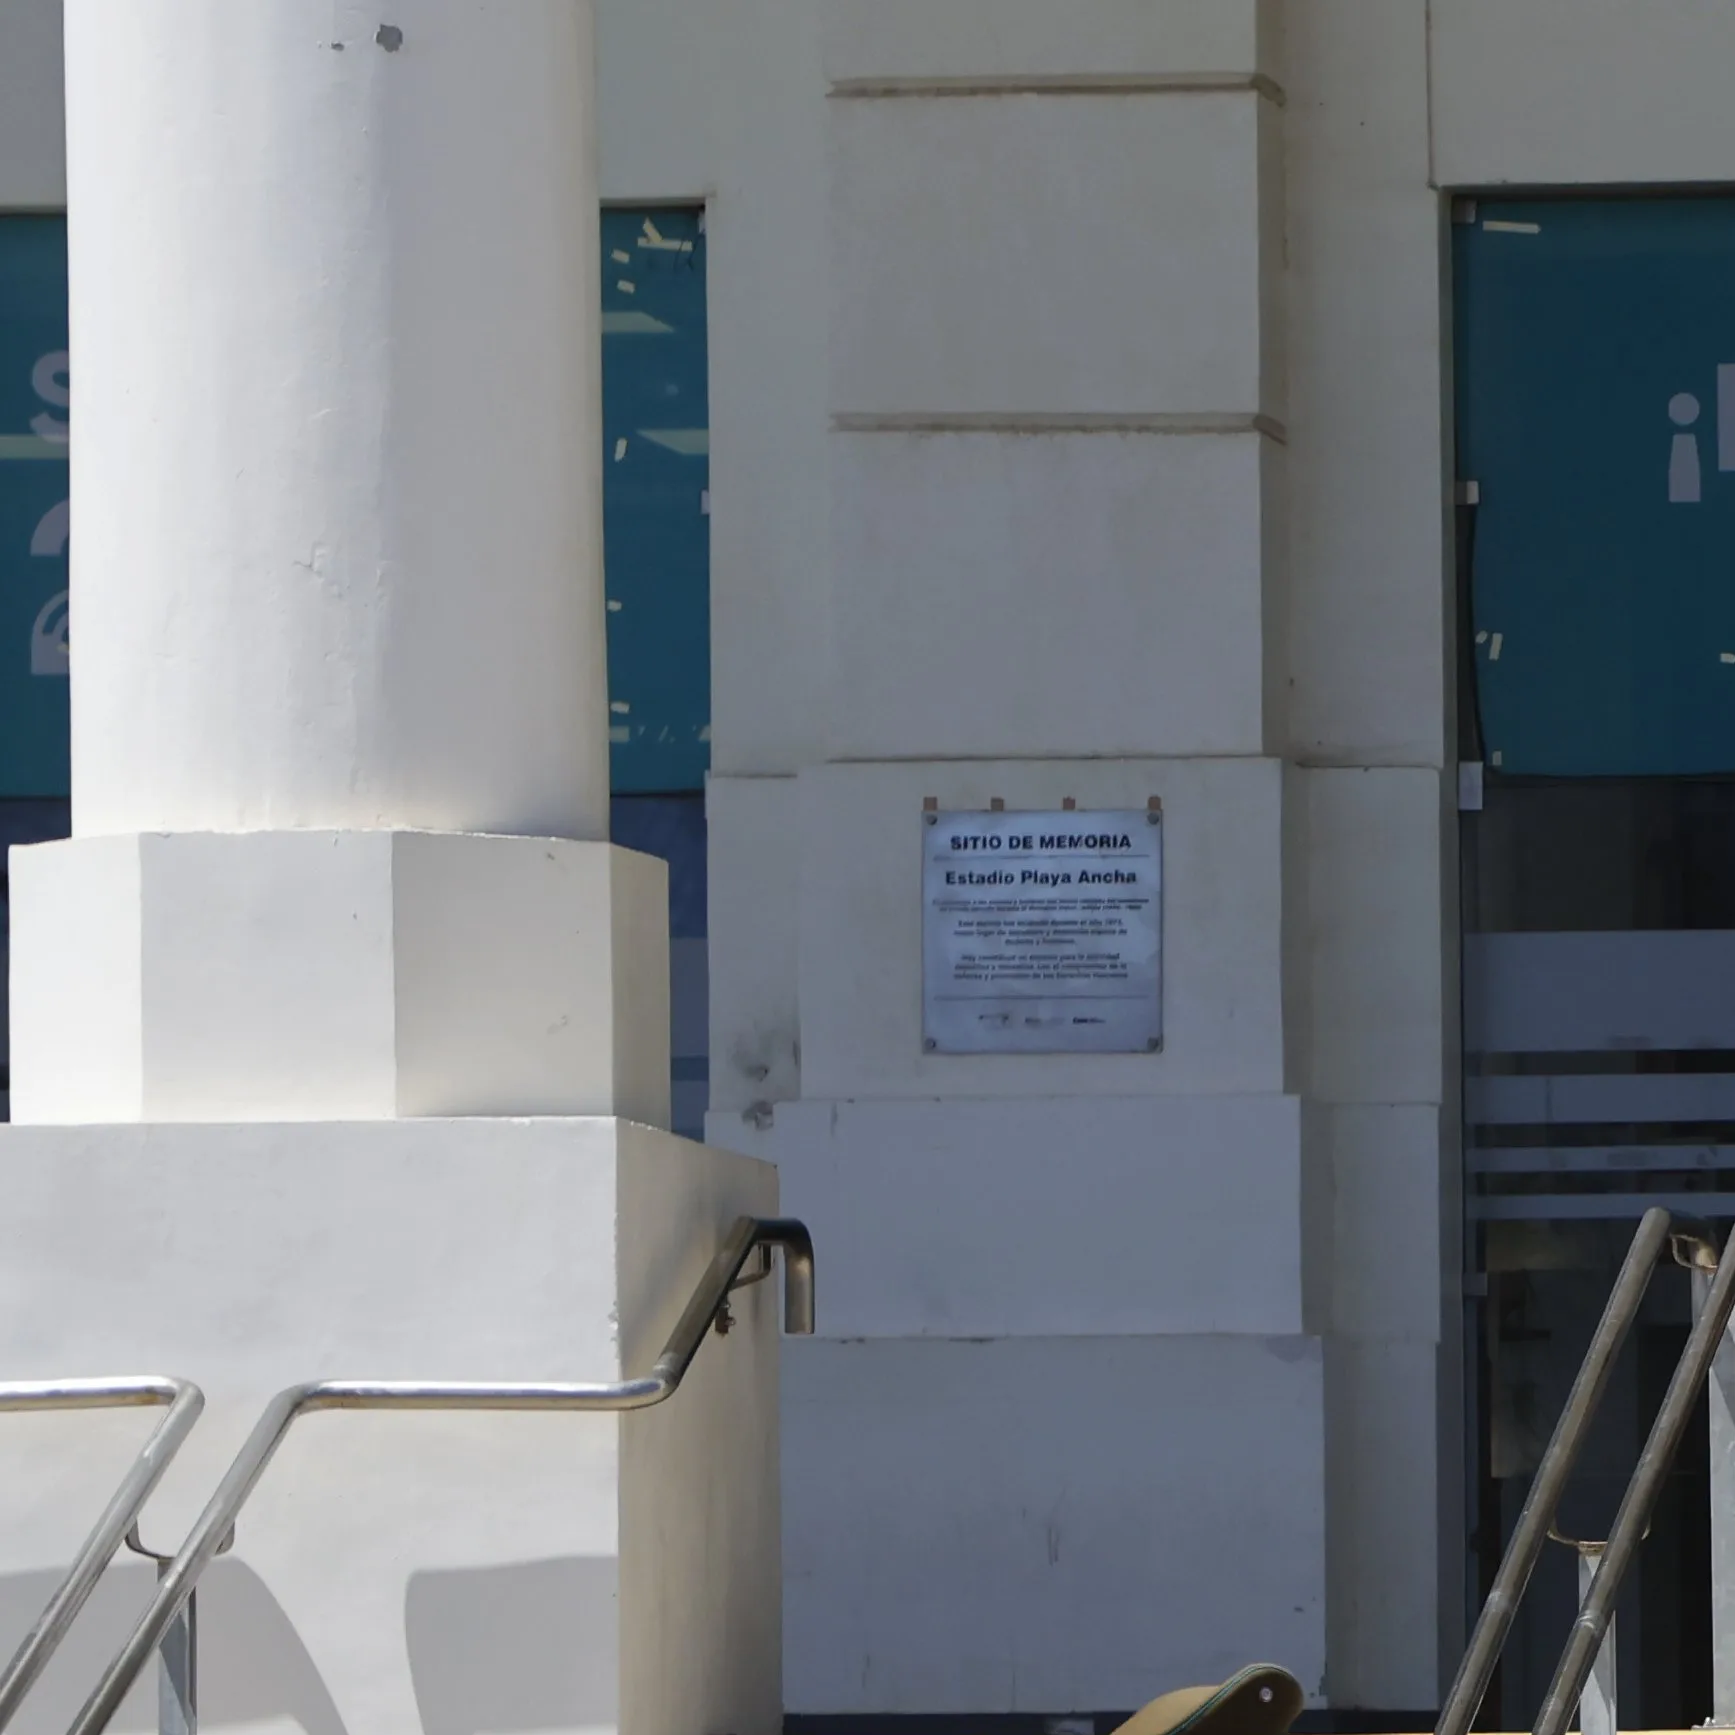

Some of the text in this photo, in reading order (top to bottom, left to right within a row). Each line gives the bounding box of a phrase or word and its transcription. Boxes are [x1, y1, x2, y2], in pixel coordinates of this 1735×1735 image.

[950, 834, 1132, 850] SITIO DE MEMORIA
[945, 869, 1137, 887] Estadio Playa Ancha
